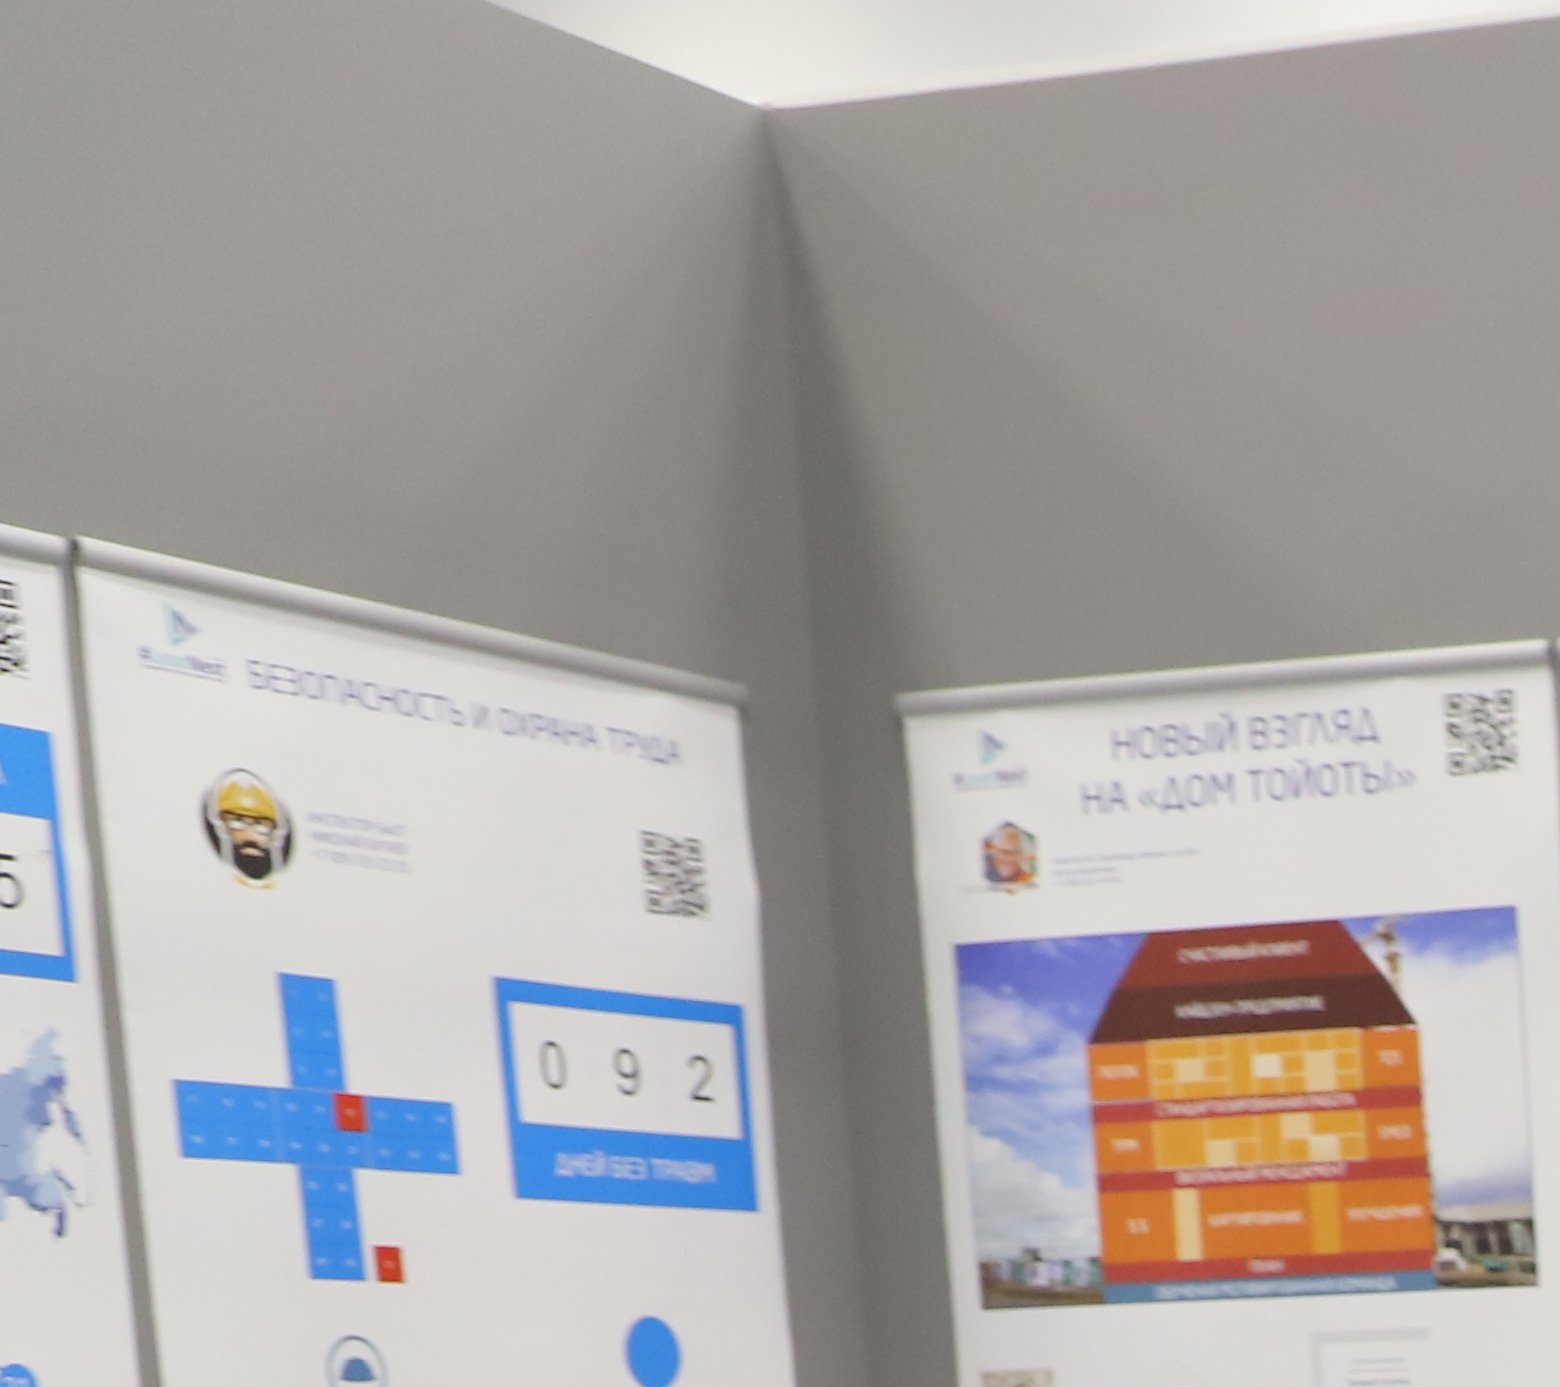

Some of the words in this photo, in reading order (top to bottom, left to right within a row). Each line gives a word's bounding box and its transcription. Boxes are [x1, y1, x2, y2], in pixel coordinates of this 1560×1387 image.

[246, 657, 467, 728] БЕЗОПАСНОСТЬ
[471, 701, 493, 730] И
[497, 706, 600, 751] ОХРАНА
[604, 725, 684, 766] ТРУДА
[1110, 712, 1241, 762] НОВЫЙ
[1247, 706, 1382, 751] ВЗГЛЯД
[1079, 779, 1131, 816] НА
